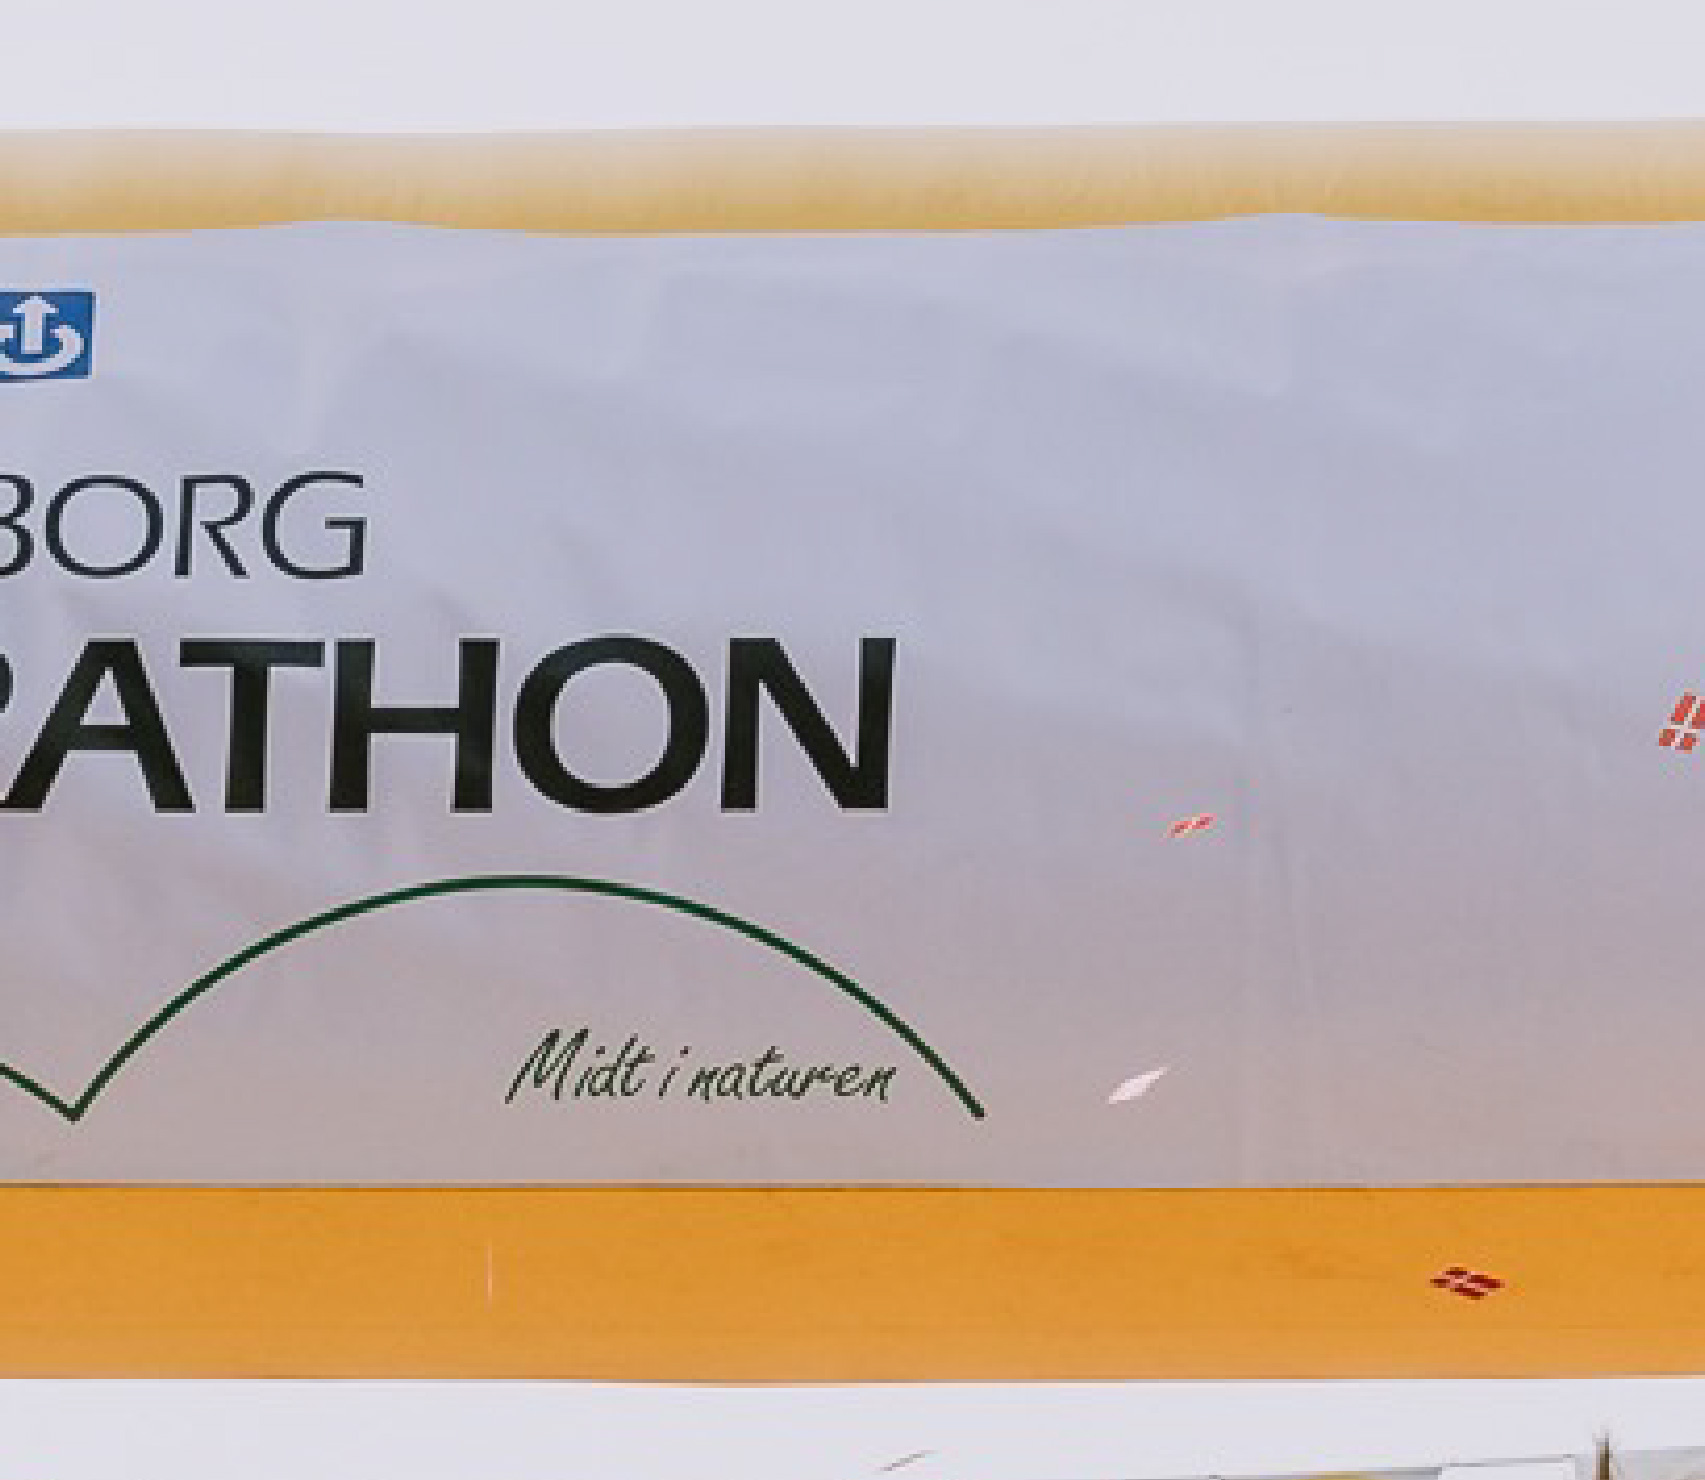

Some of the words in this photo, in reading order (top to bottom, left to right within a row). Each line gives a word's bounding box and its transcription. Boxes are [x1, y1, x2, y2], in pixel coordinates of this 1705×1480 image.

[505, 1028, 655, 1104] Midt
[659, 1046, 691, 1099] i
[689, 1046, 896, 1104] naturen
